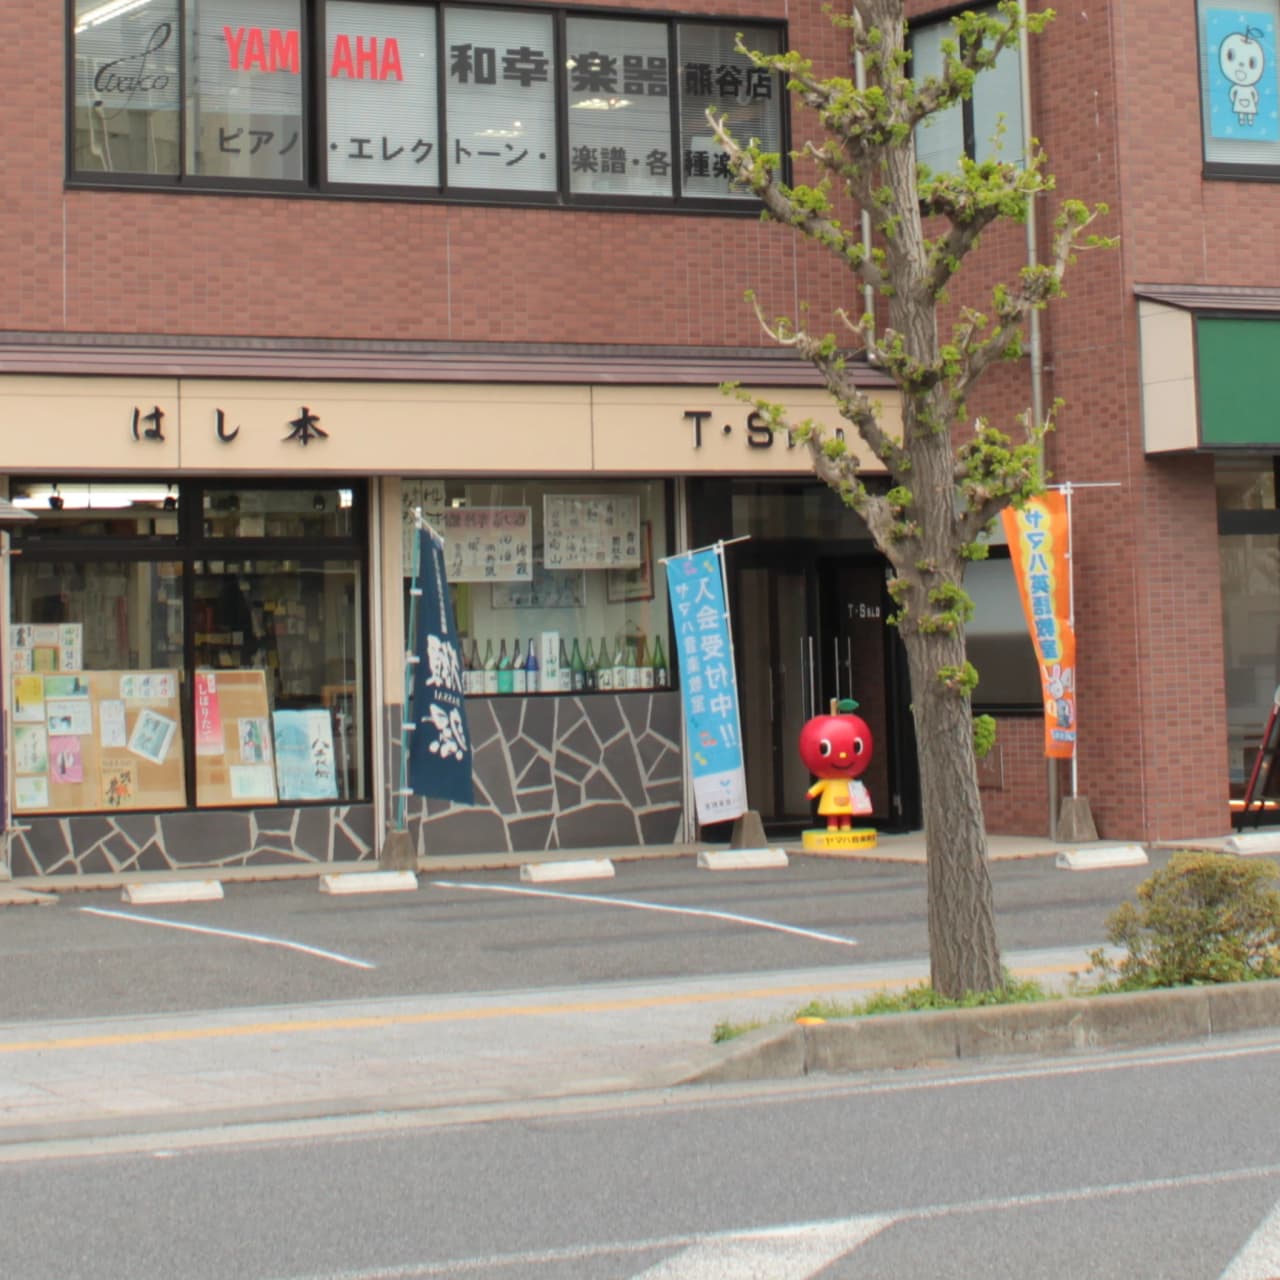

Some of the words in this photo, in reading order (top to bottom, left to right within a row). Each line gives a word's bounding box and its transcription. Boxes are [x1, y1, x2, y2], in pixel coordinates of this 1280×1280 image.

[223, 25, 404, 83] YAMAHA
[130, 405, 329, 446] はし本
